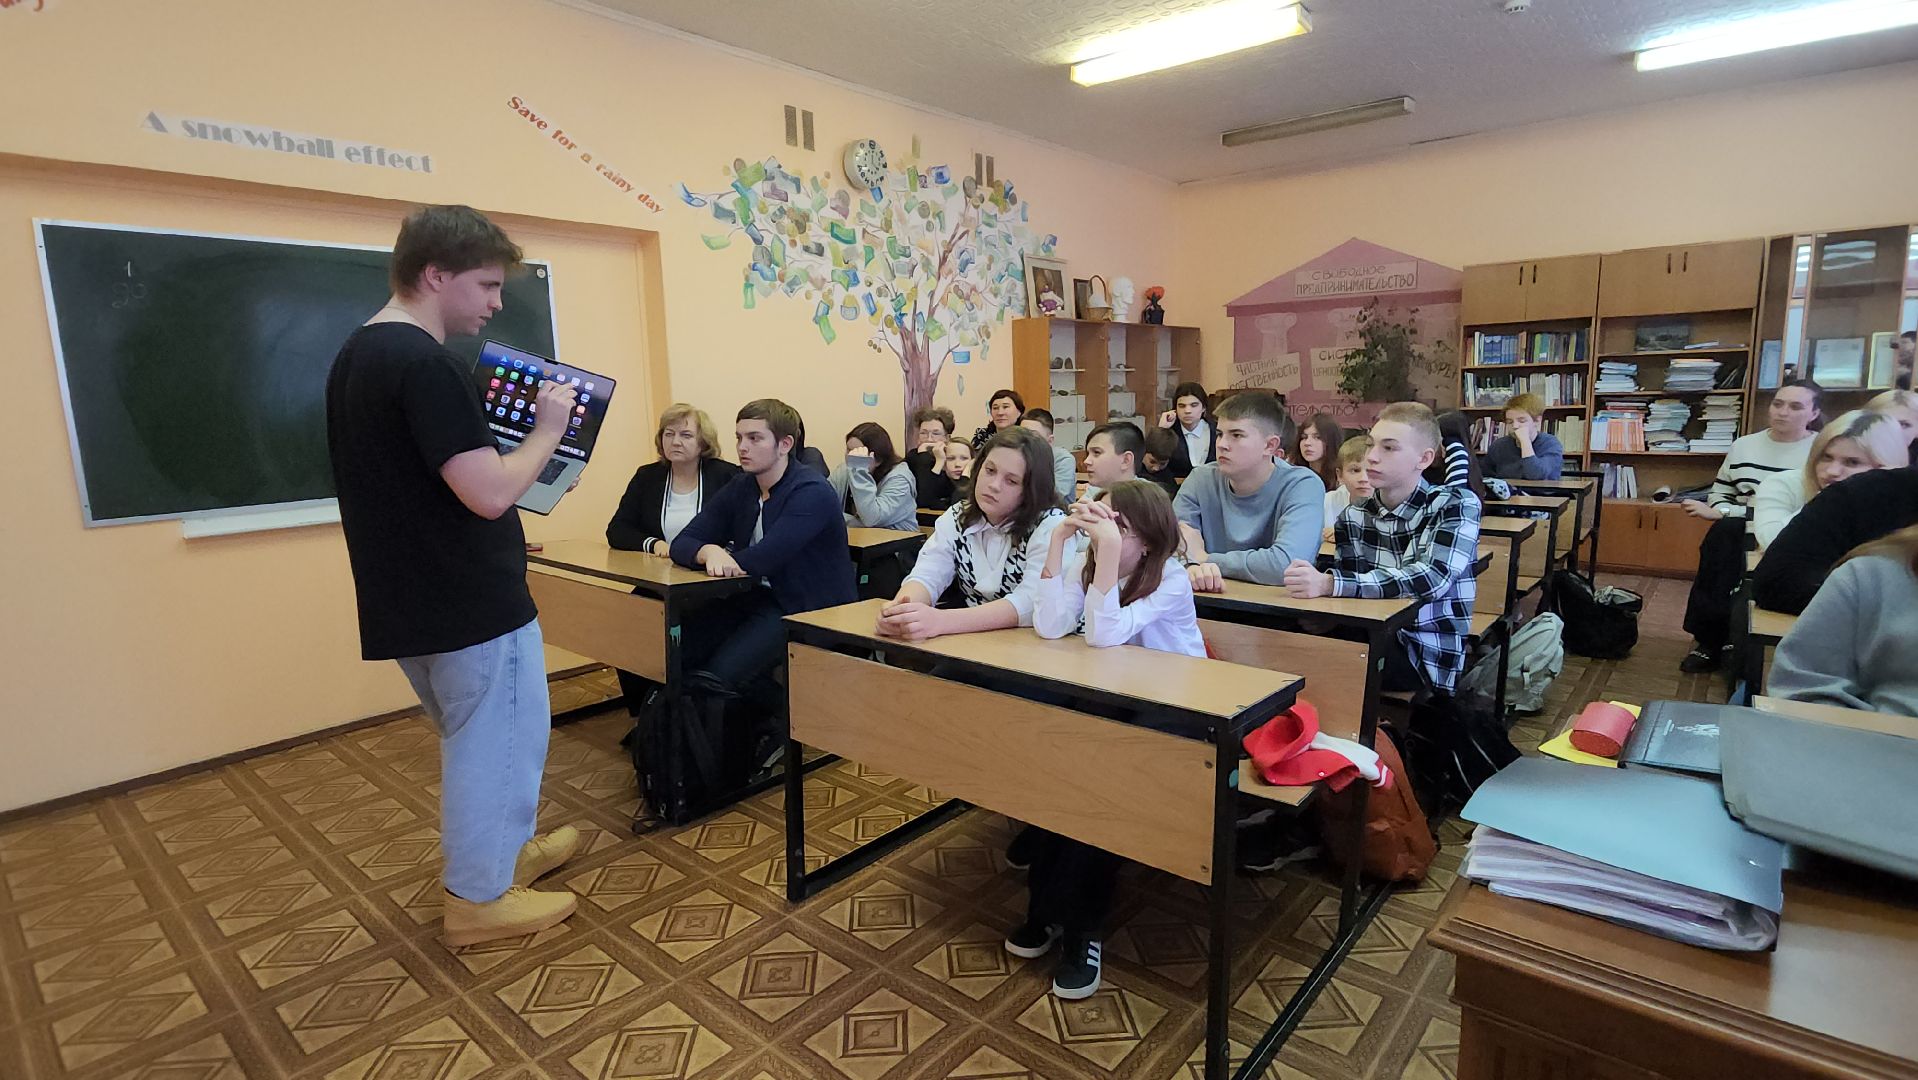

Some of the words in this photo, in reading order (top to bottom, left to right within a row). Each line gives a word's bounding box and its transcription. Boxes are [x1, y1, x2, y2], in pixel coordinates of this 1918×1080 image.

[141, 111, 168, 133] A
[181, 119, 334, 159] snowball
[344, 145, 433, 174] effect
[507, 96, 548, 130] Save
[551, 129, 577, 150] for
[580, 152, 592, 164] a
[595, 163, 634, 193] rainy
[637, 193, 664, 214] day
[1296, 273, 1415, 296] ПРЕДПРИНИМАТЕЛЬСТВО
